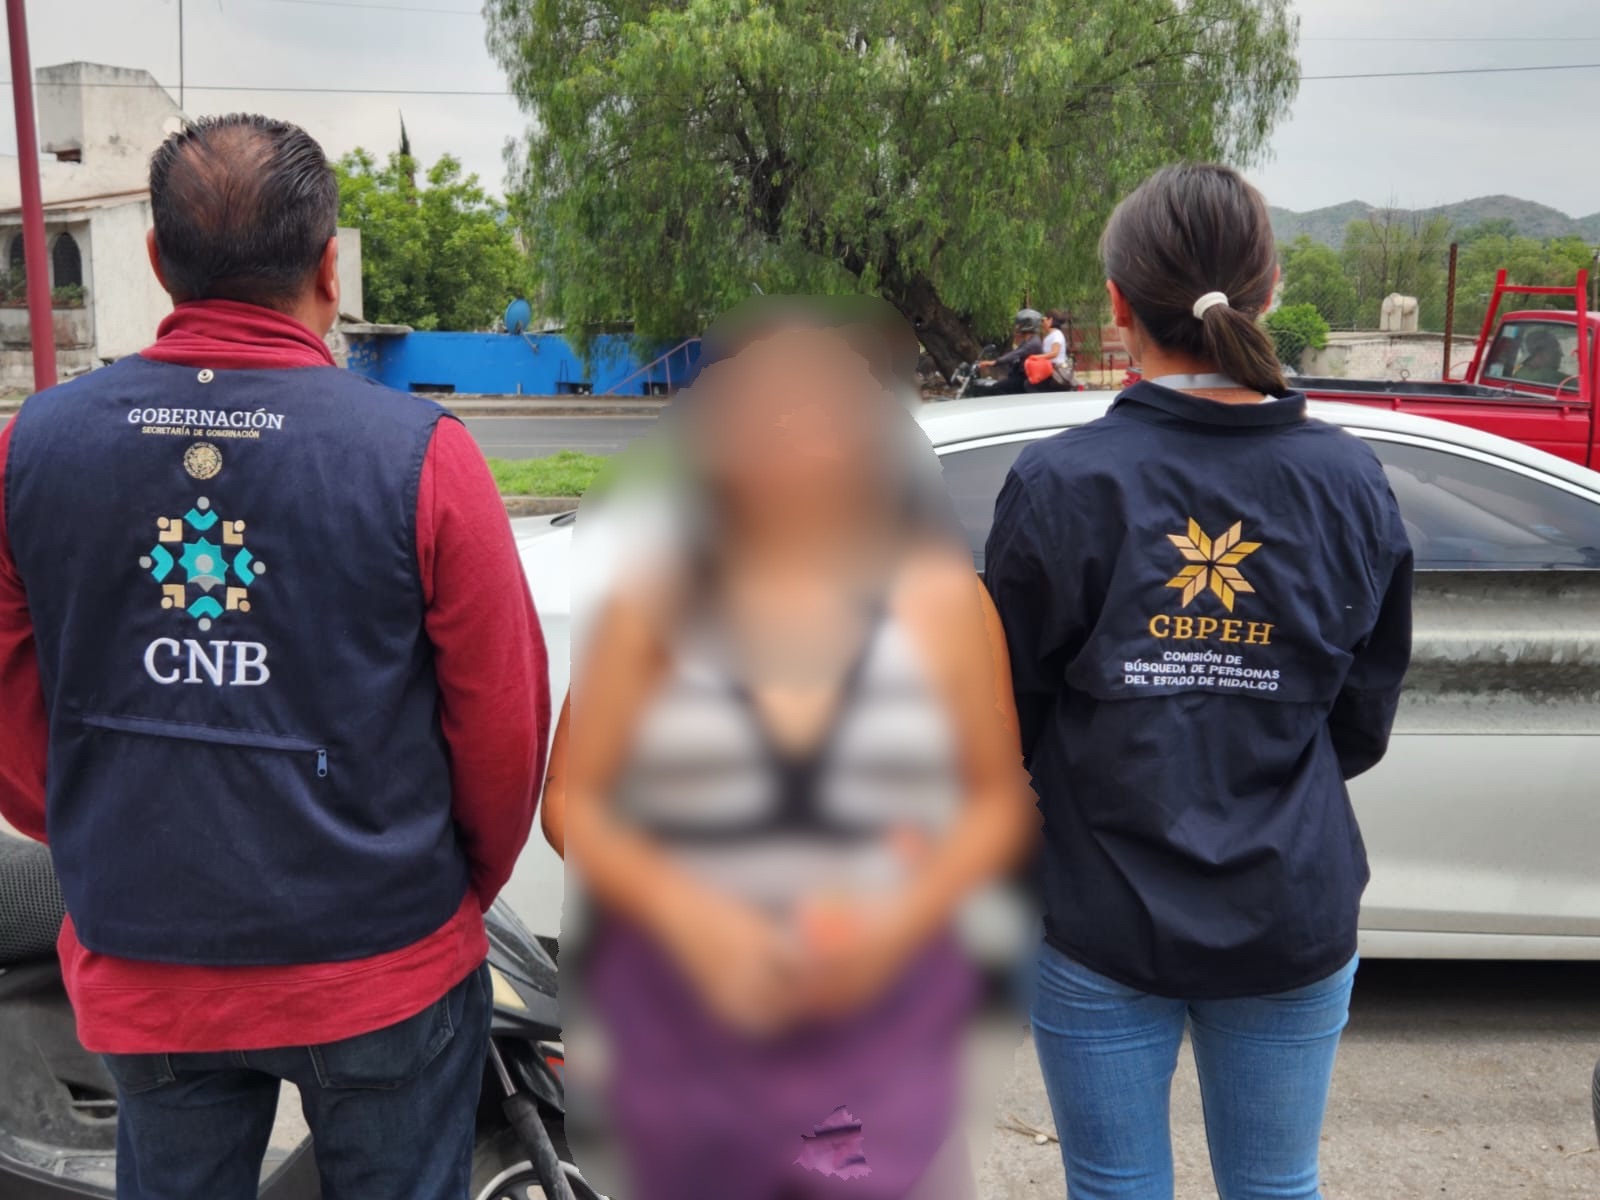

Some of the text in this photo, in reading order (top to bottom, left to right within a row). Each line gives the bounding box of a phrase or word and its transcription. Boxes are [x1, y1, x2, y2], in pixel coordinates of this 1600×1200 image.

[128, 408, 285, 430] GOBERNACIÓN
[141, 425, 260, 439] SECRETARÍA DE GOBERNACIÓN
[1149, 614, 1275, 645] CBPEH
[143, 637, 270, 686] CNB
[1163, 650, 1243, 665] COMISIÓN DE
[1124, 658, 1280, 680] BÚSQUEDA DE PERSONAS
[1124, 674, 1278, 691] DEL ESTADO DE HIDALGO
